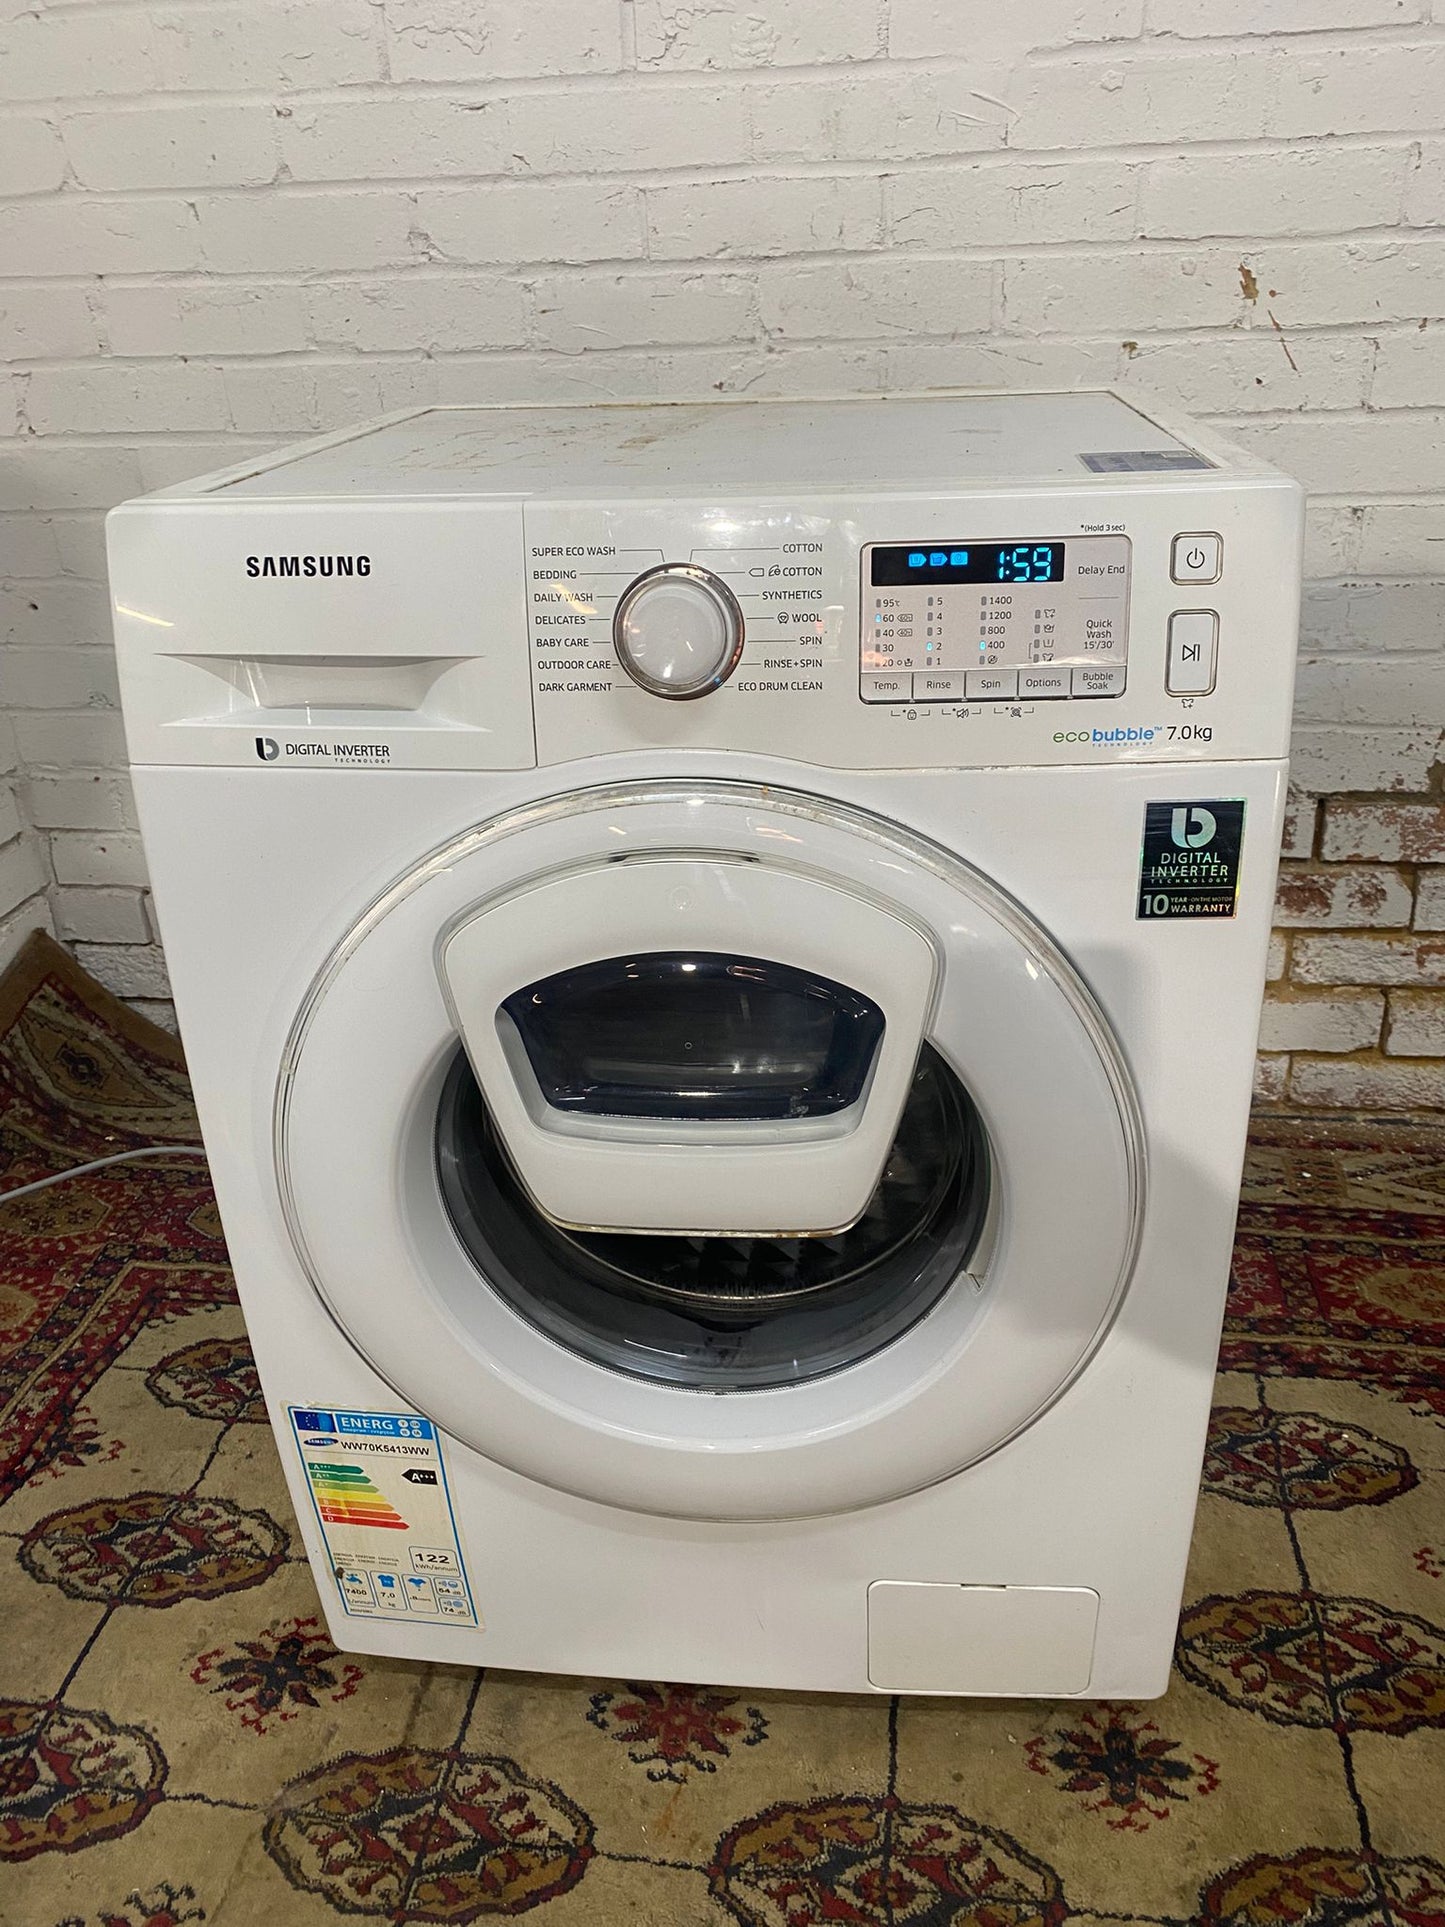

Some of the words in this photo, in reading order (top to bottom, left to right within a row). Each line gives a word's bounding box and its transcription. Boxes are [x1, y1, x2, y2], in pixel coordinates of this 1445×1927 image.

[531, 547, 563, 557] SUPER
[565, 547, 585, 556] ECO
[587, 546, 616, 556] WASH
[782, 543, 823, 553] COTTON
[246, 555, 371, 577] SAMSUNG
[998, 546, 1052, 582] 1:59
[533, 570, 577, 580] BEDDING
[782, 567, 823, 577] COTTON
[1077, 565, 1105, 576] Delay
[1107, 565, 1125, 574] End
[534, 593, 562, 602] DAILY
[564, 593, 593, 602] WASH
[762, 590, 822, 600] SYNTHETICS
[937, 597, 943, 606] 5
[989, 596, 1013, 605] 1400
[535, 616, 586, 625] DELICATES
[791, 613, 822, 623] WOOL
[882, 614, 895, 623] 60
[988, 611, 1012, 620] 1200
[1086, 619, 1113, 629] Quick
[882, 629, 895, 638] 40
[936, 627, 943, 636] 3
[987, 626, 1006, 635] 800
[1086, 630, 1112, 639] Wash
[536, 639, 562, 648] BABY
[564, 639, 589, 647] CARE
[799, 636, 822, 645] SPIN
[987, 641, 1006, 649] 400
[882, 643, 895, 653] 30
[936, 642, 942, 651] 2
[537, 660, 585, 670] OUTDOOR
[586, 660, 611, 669] CARE
[882, 658, 894, 667] 20
[936, 657, 941, 666] 1
[1082, 672, 1114, 681] Bubble
[539, 682, 565, 692] DARK
[566, 682, 613, 692] GARMENT
[738, 682, 757, 691] ECO
[759, 681, 789, 691] DRUM
[790, 681, 823, 691] CLEAN
[874, 681, 900, 690] Temp.
[926, 680, 952, 689] Rinse
[981, 679, 1001, 690] Spin
[1025, 678, 1062, 688] Options
[1086, 681, 1109, 690] Soak
[1052, 731, 1091, 743] eco
[285, 744, 331, 756] DIGITAL
[333, 744, 391, 757] INVERTER
[1160, 852, 1222, 865] DIGITAL
[1150, 865, 1229, 877] INVERTER
[1142, 894, 1170, 915] 10
[1170, 904, 1231, 913] WARRANTY
[341, 1416, 394, 1430] ENERG
[341, 1440, 429, 1456] WW70K5413WW
[415, 1553, 450, 1565] 122
[345, 1588, 368, 1596] 7400
